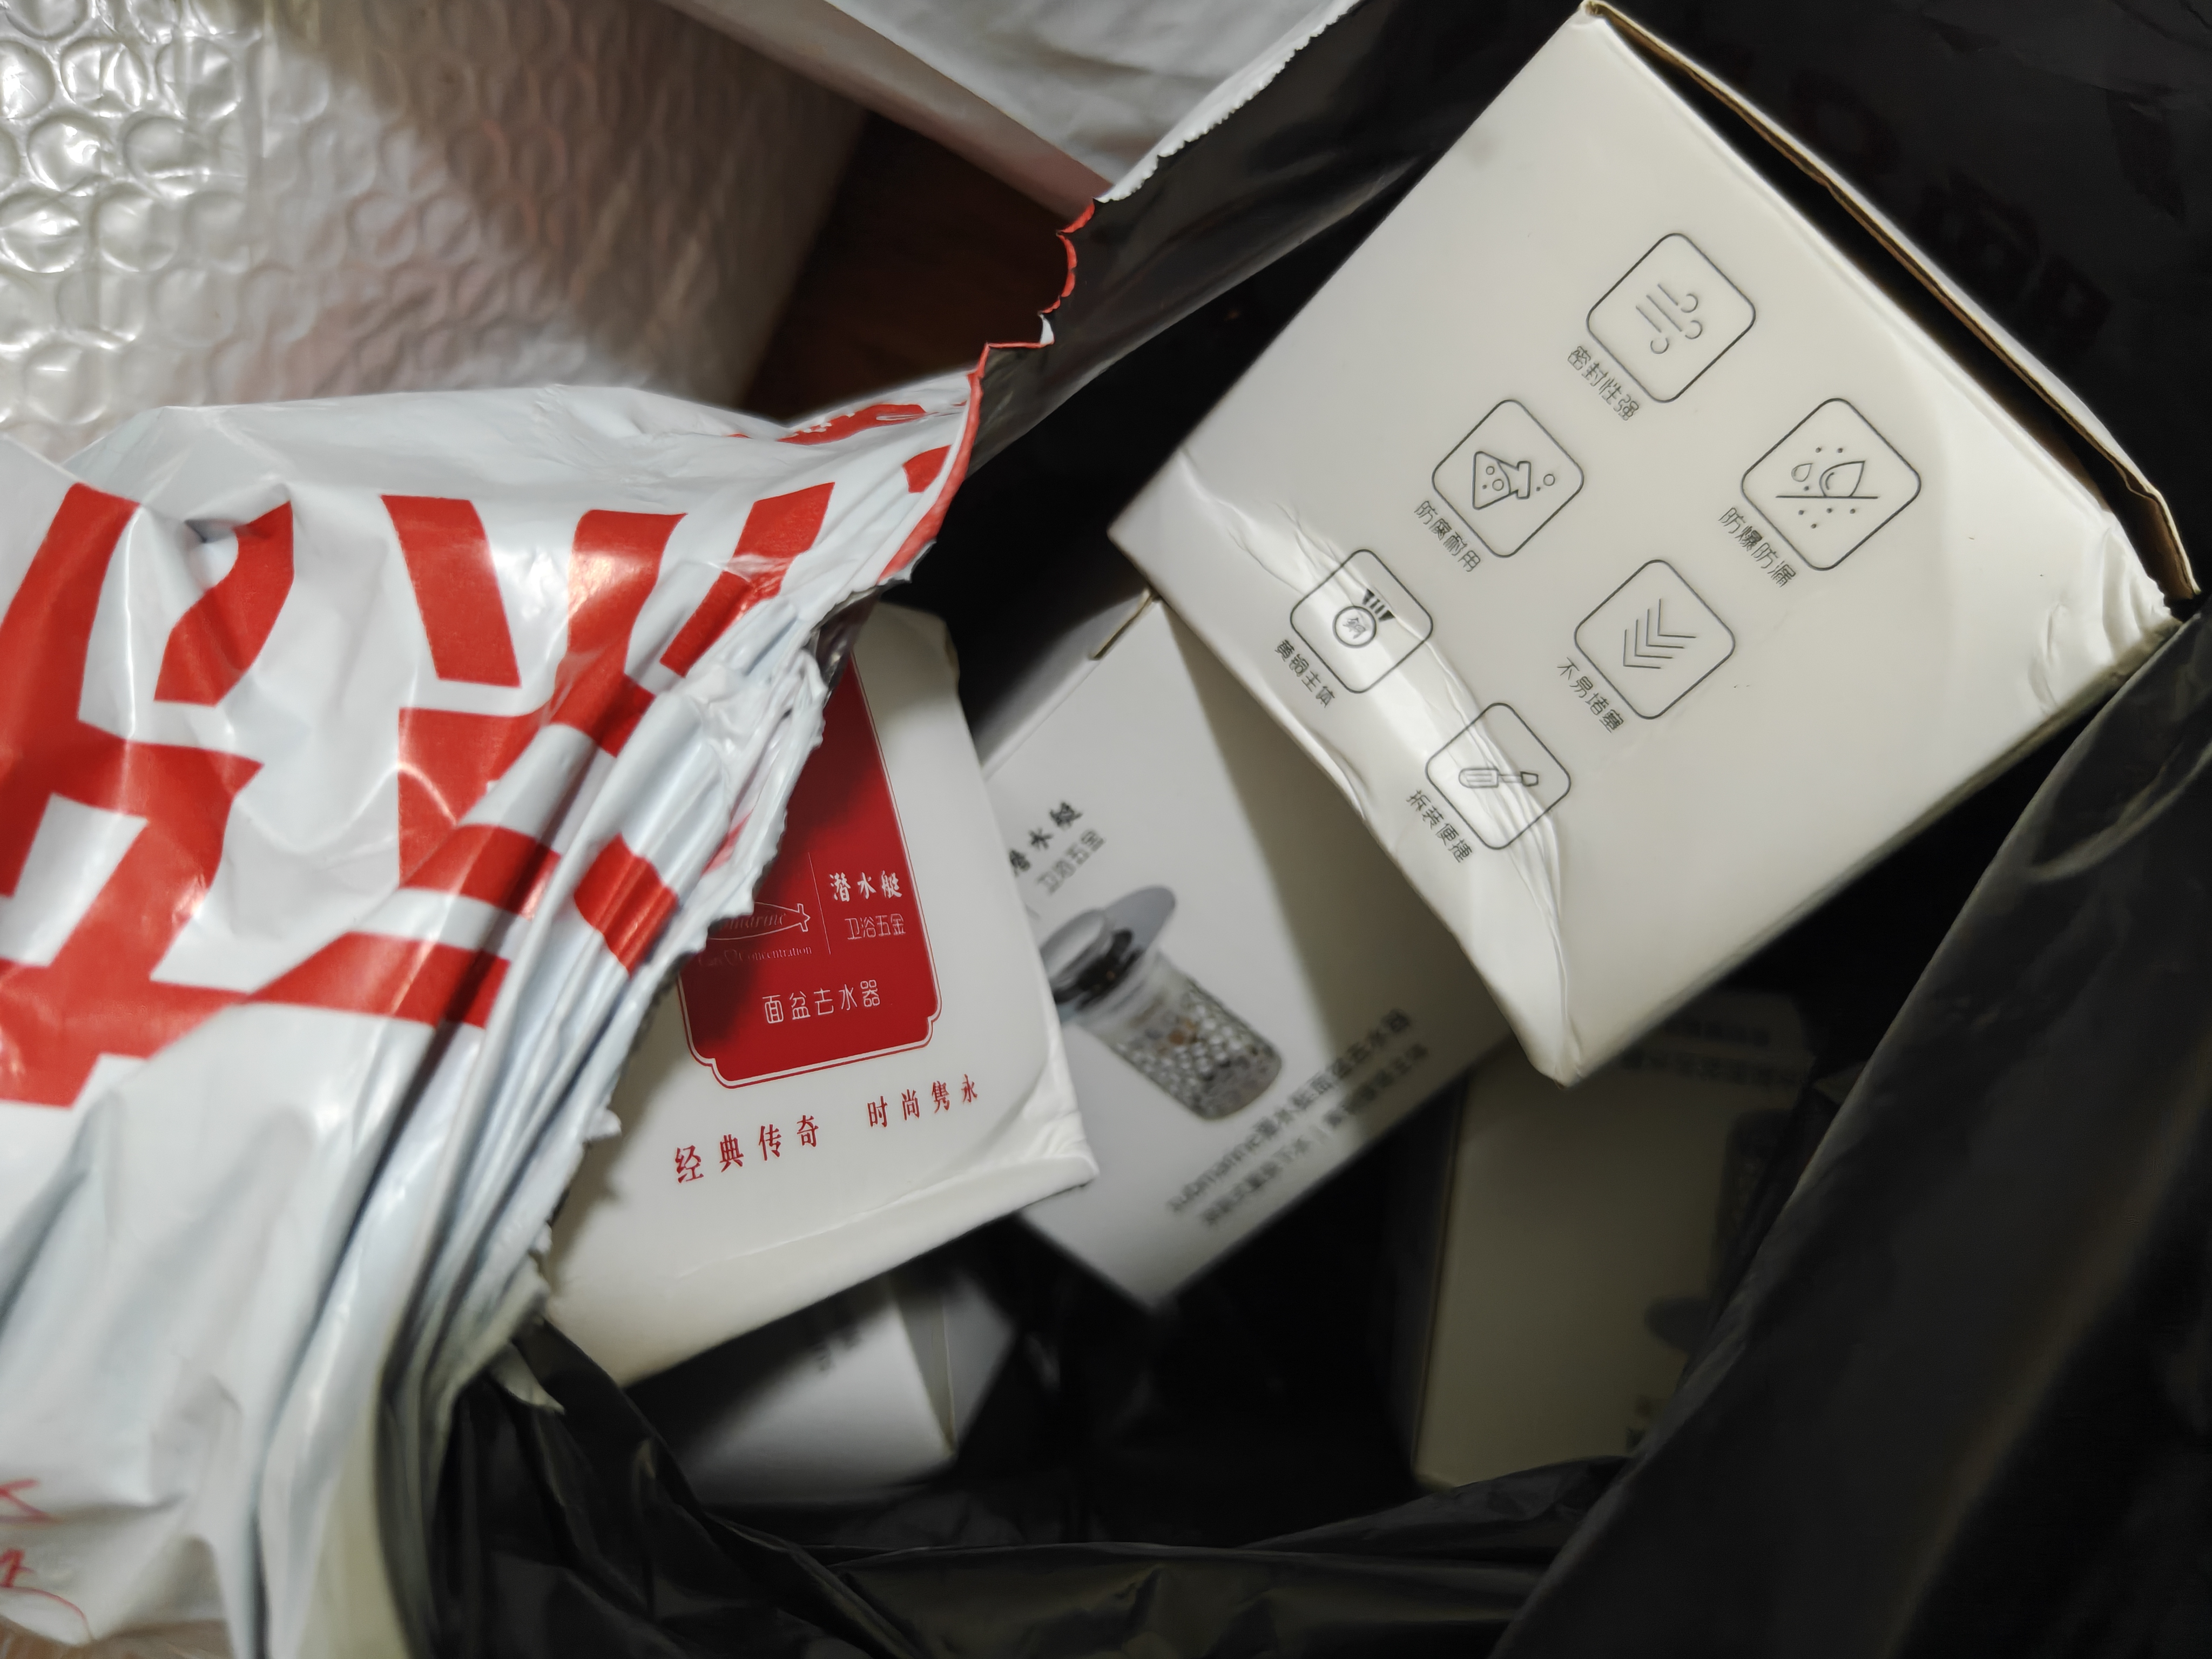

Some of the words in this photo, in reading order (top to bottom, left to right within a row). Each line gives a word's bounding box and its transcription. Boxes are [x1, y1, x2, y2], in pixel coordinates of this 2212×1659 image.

[1567, 346, 1640, 421] 密封性强
[1413, 500, 1481, 572] 防腐耐用
[1717, 507, 1797, 588] 防爆防漏
[1274, 639, 1336, 709] 黄铜主体
[1556, 656, 1624, 733] 不易堵塞
[1406, 790, 1473, 863] 拆装便捷
[828, 870, 903, 902] 潜水艇
[844, 914, 906, 940] 卫浴五金
[762, 980, 881, 1024] 面盆去水器
[675, 1115, 819, 1184] 经典传奇
[867, 1074, 979, 1128] 时尚隽永
